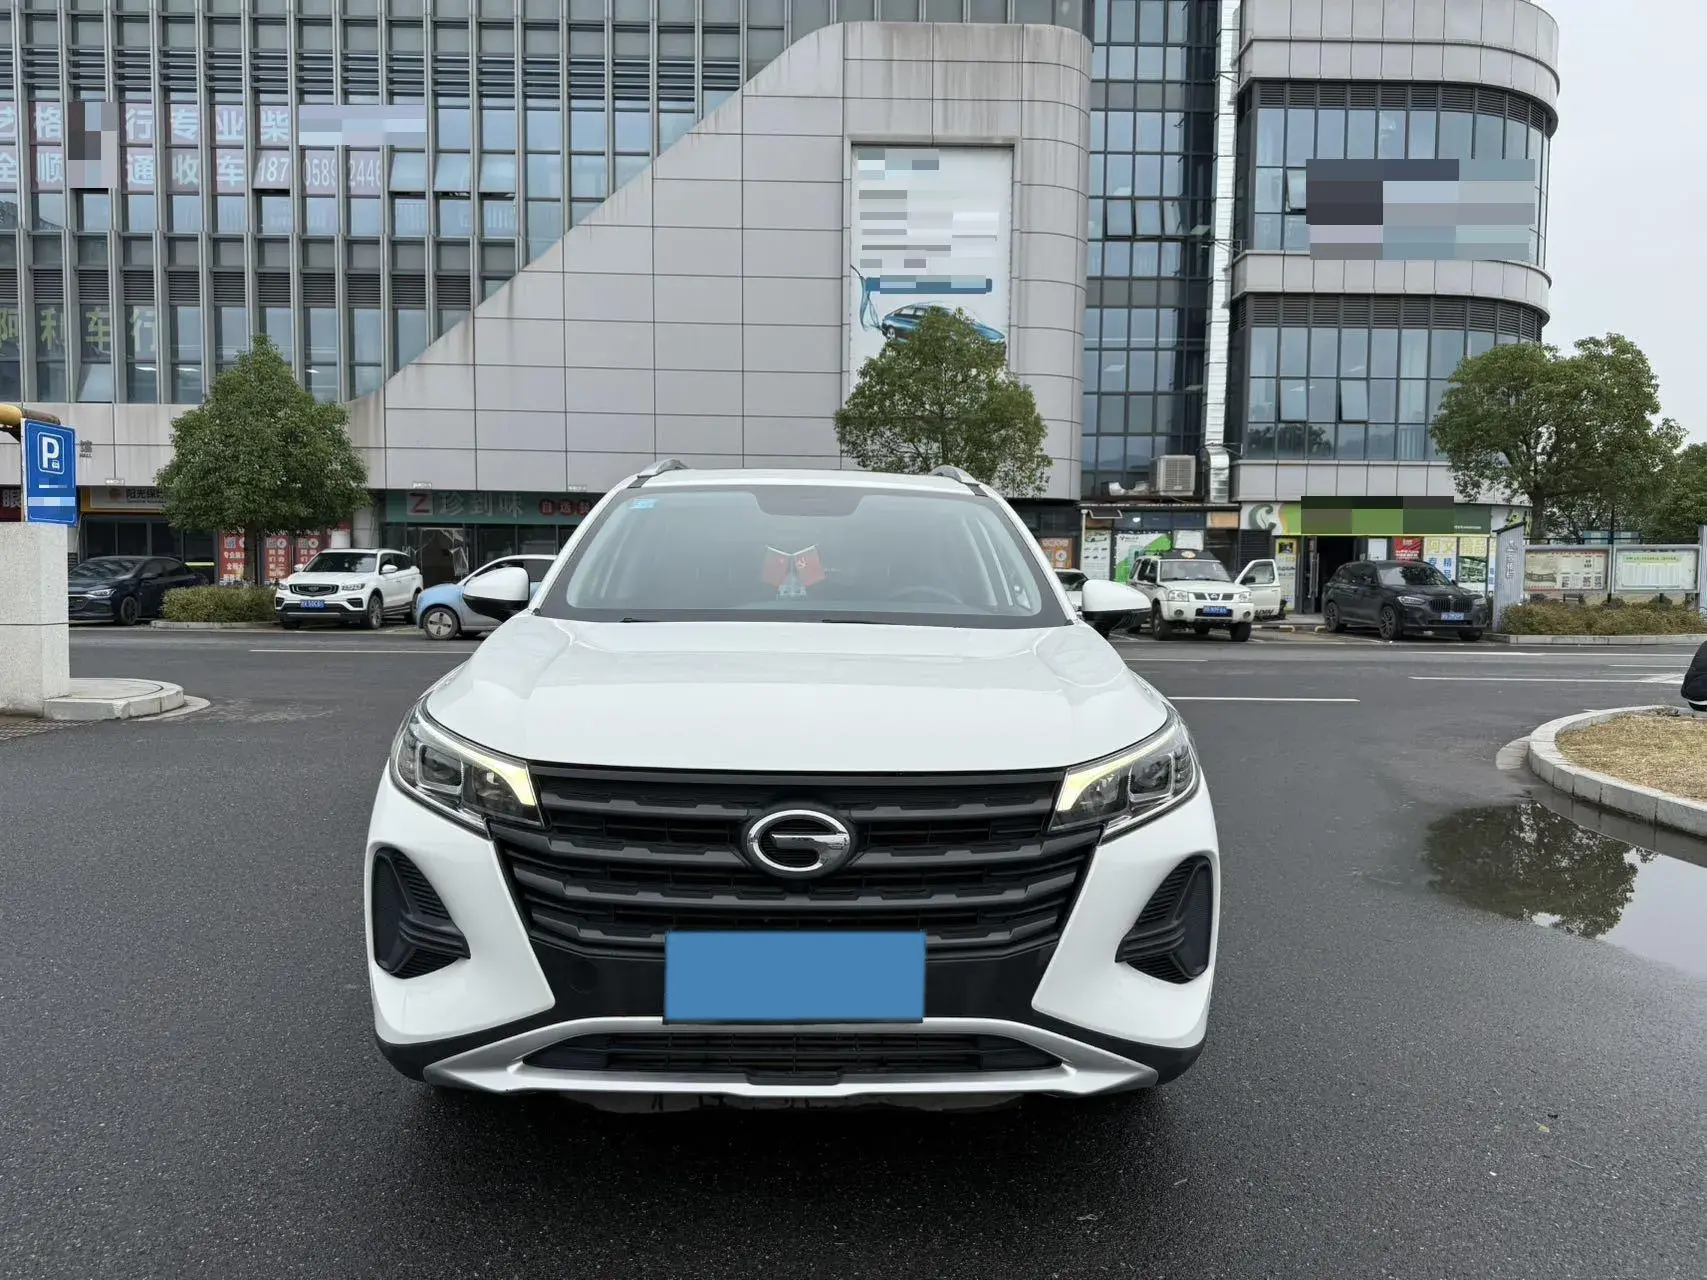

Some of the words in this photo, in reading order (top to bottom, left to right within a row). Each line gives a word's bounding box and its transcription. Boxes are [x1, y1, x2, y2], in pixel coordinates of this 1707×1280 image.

[42, 436, 60, 469] P
[438, 492, 524, 520] 珍到味
